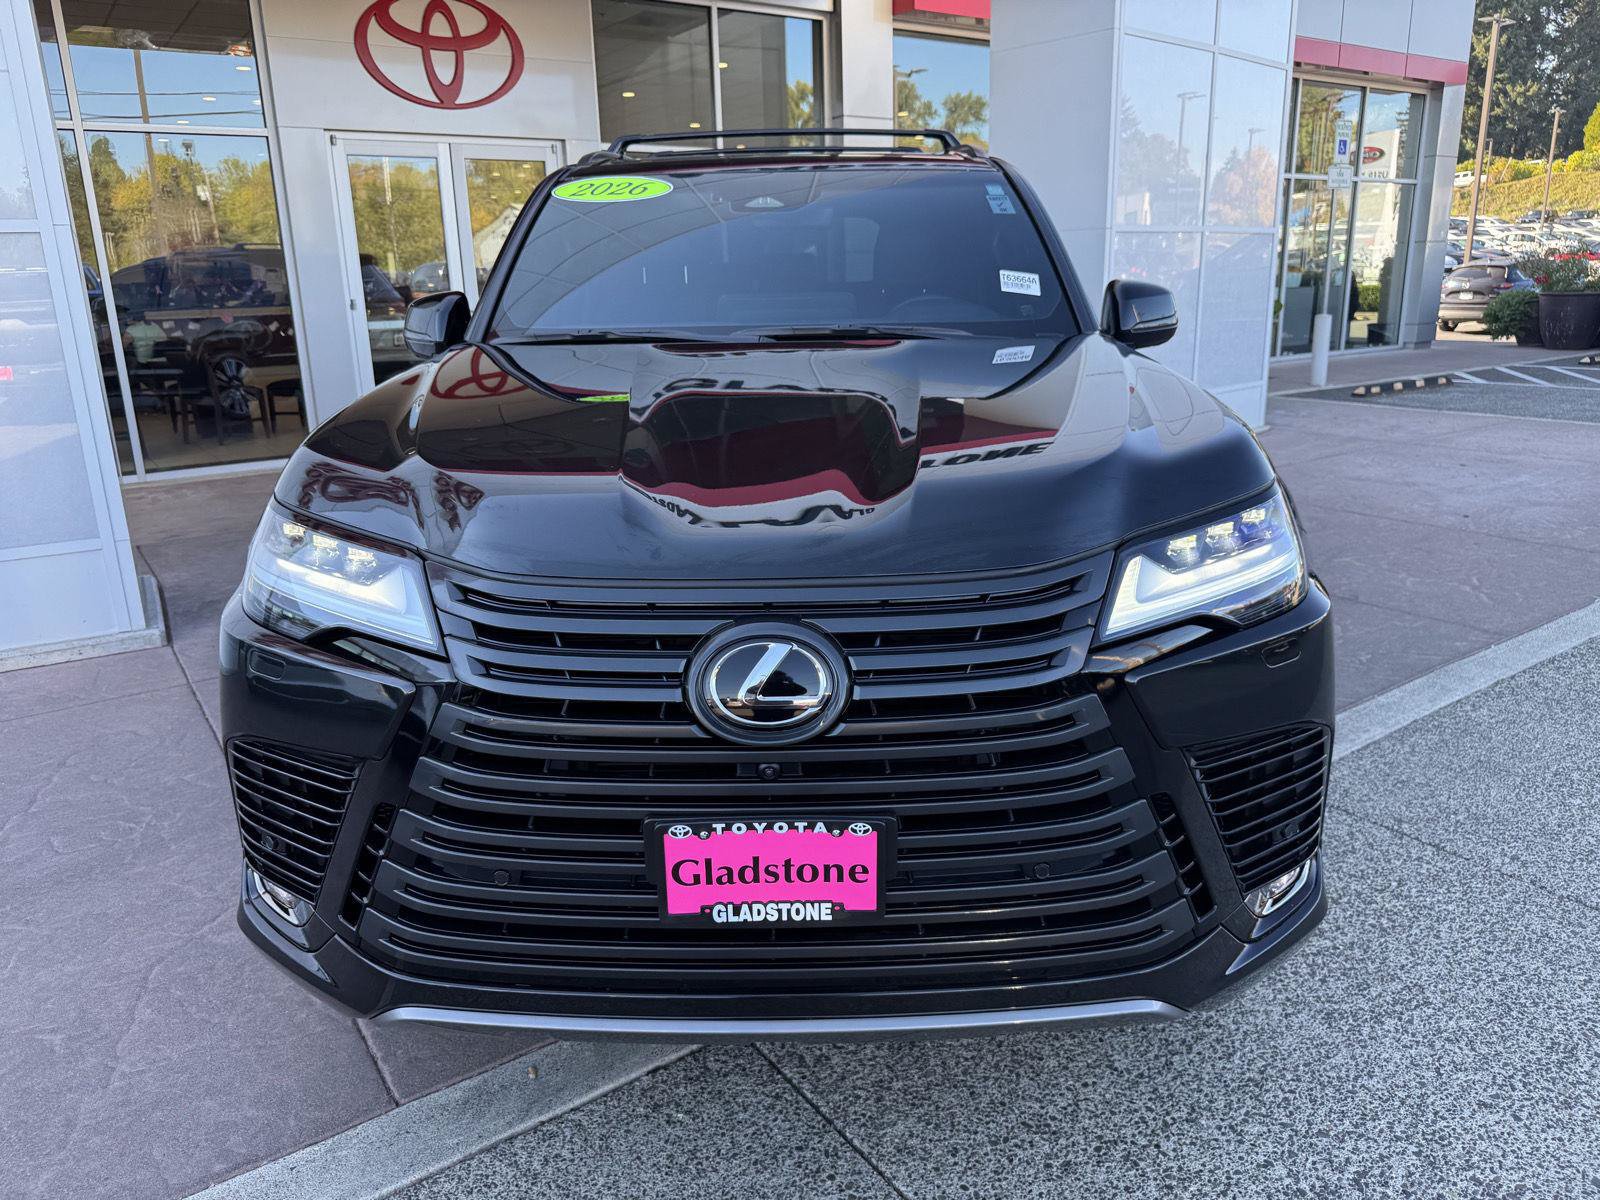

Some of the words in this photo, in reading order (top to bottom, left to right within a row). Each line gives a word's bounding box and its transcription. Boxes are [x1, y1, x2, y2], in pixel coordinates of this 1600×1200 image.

[569, 181, 654, 198] 2026
[712, 821, 828, 836] TOYOTA
[671, 856, 870, 887] Gladstone
[712, 902, 833, 924] GLADSTONE
